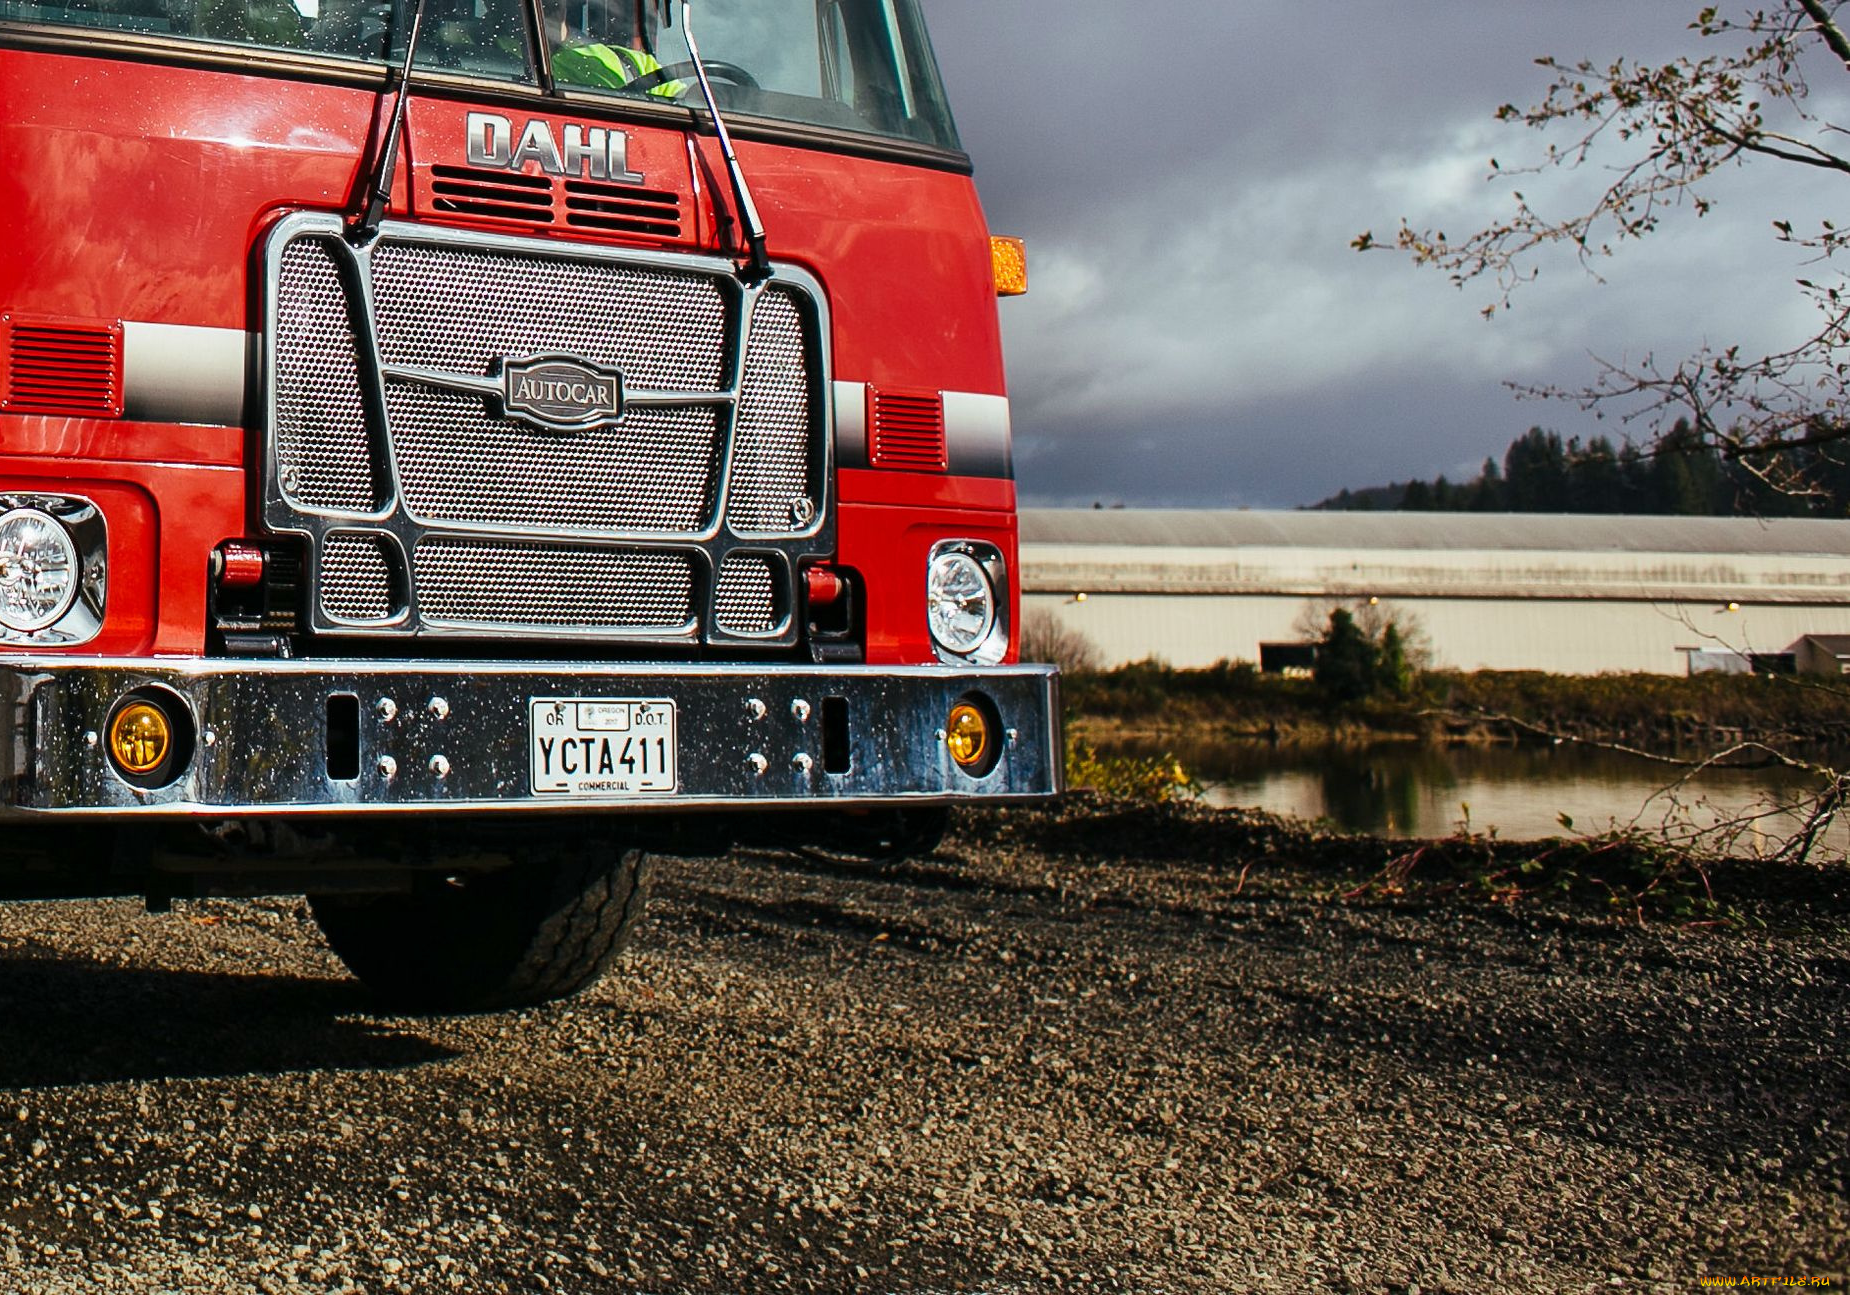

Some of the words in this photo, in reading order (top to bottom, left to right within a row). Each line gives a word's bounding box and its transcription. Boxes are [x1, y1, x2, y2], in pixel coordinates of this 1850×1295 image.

[466, 110, 646, 185] DAHL
[514, 375, 612, 406] AUTOCAR
[546, 713, 564, 725] OR
[538, 736, 666, 775] YCTA411
[578, 781, 630, 792] COMMERCIAL
